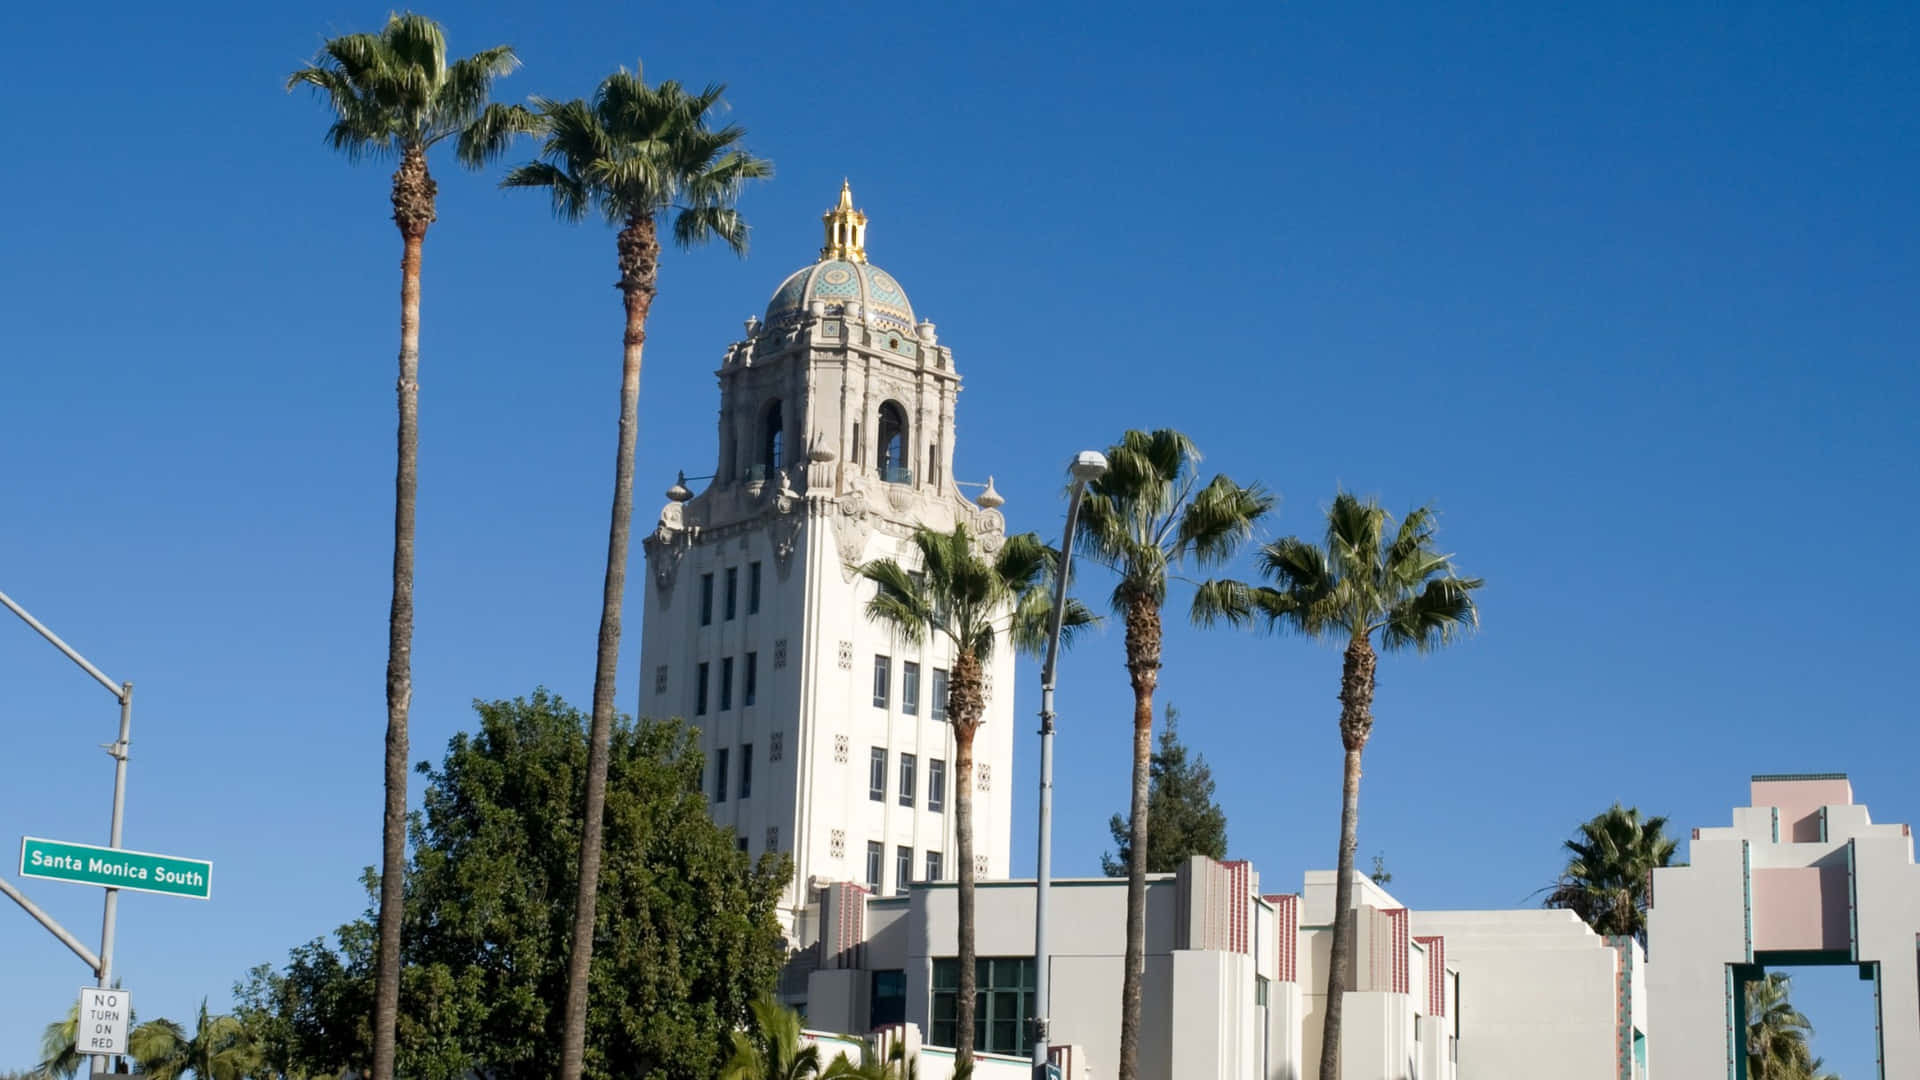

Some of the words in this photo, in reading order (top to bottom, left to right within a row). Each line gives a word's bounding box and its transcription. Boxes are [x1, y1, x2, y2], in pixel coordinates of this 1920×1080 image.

[31, 850, 82, 870] Santa
[88, 858, 148, 879] Monica
[154, 867, 203, 886] South
[95, 995, 117, 1007] NO
[90, 1010, 119, 1021] TURN
[95, 1024, 112, 1034] ON
[91, 1038, 113, 1048] RED
